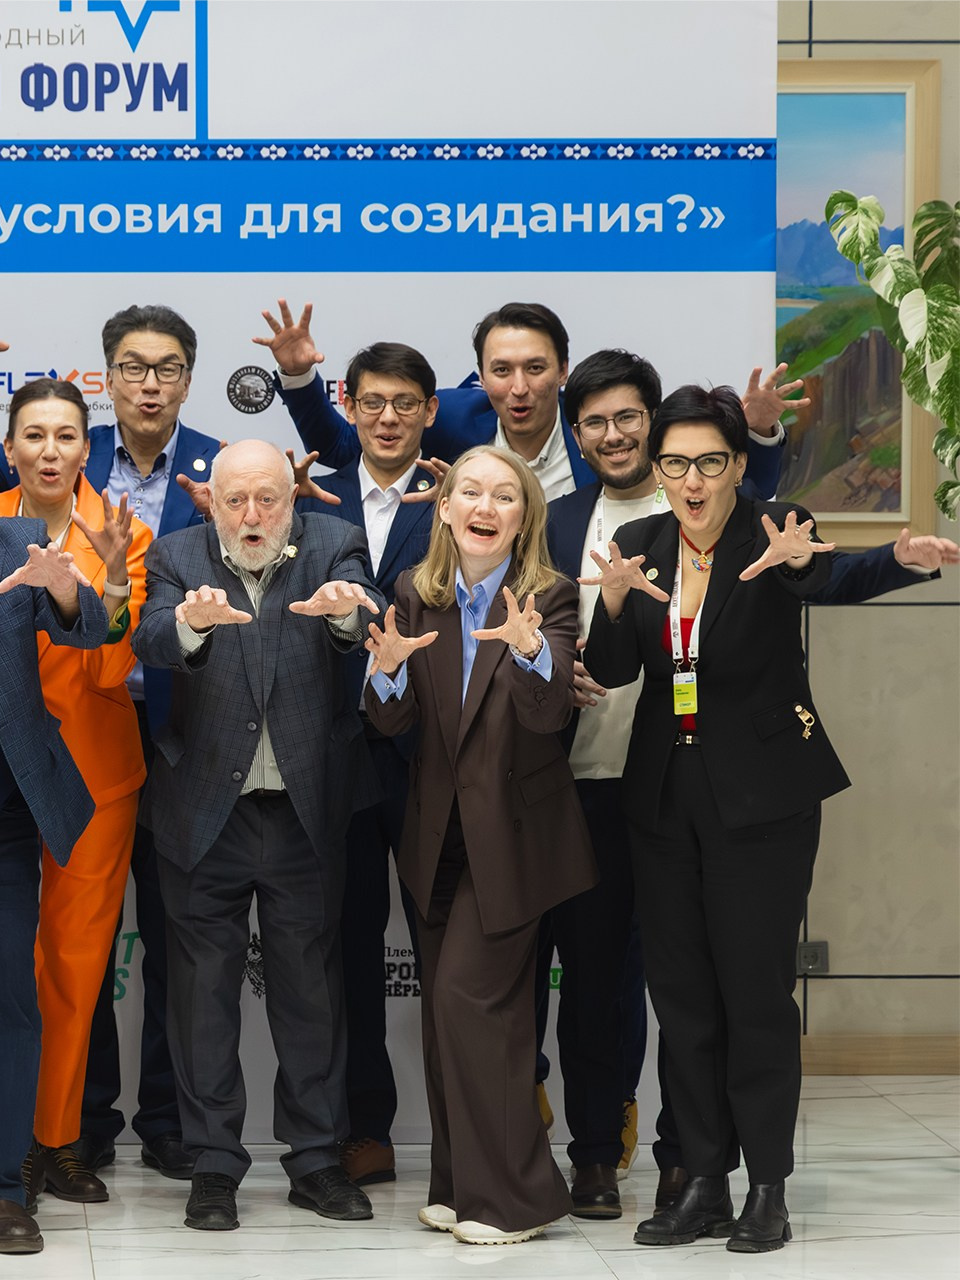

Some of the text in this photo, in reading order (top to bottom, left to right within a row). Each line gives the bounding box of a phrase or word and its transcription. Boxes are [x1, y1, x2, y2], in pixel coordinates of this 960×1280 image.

[20, 62, 188, 113] ФОРУМ
[240, 203, 341, 239] для
[361, 194, 726, 239] созидания?»
